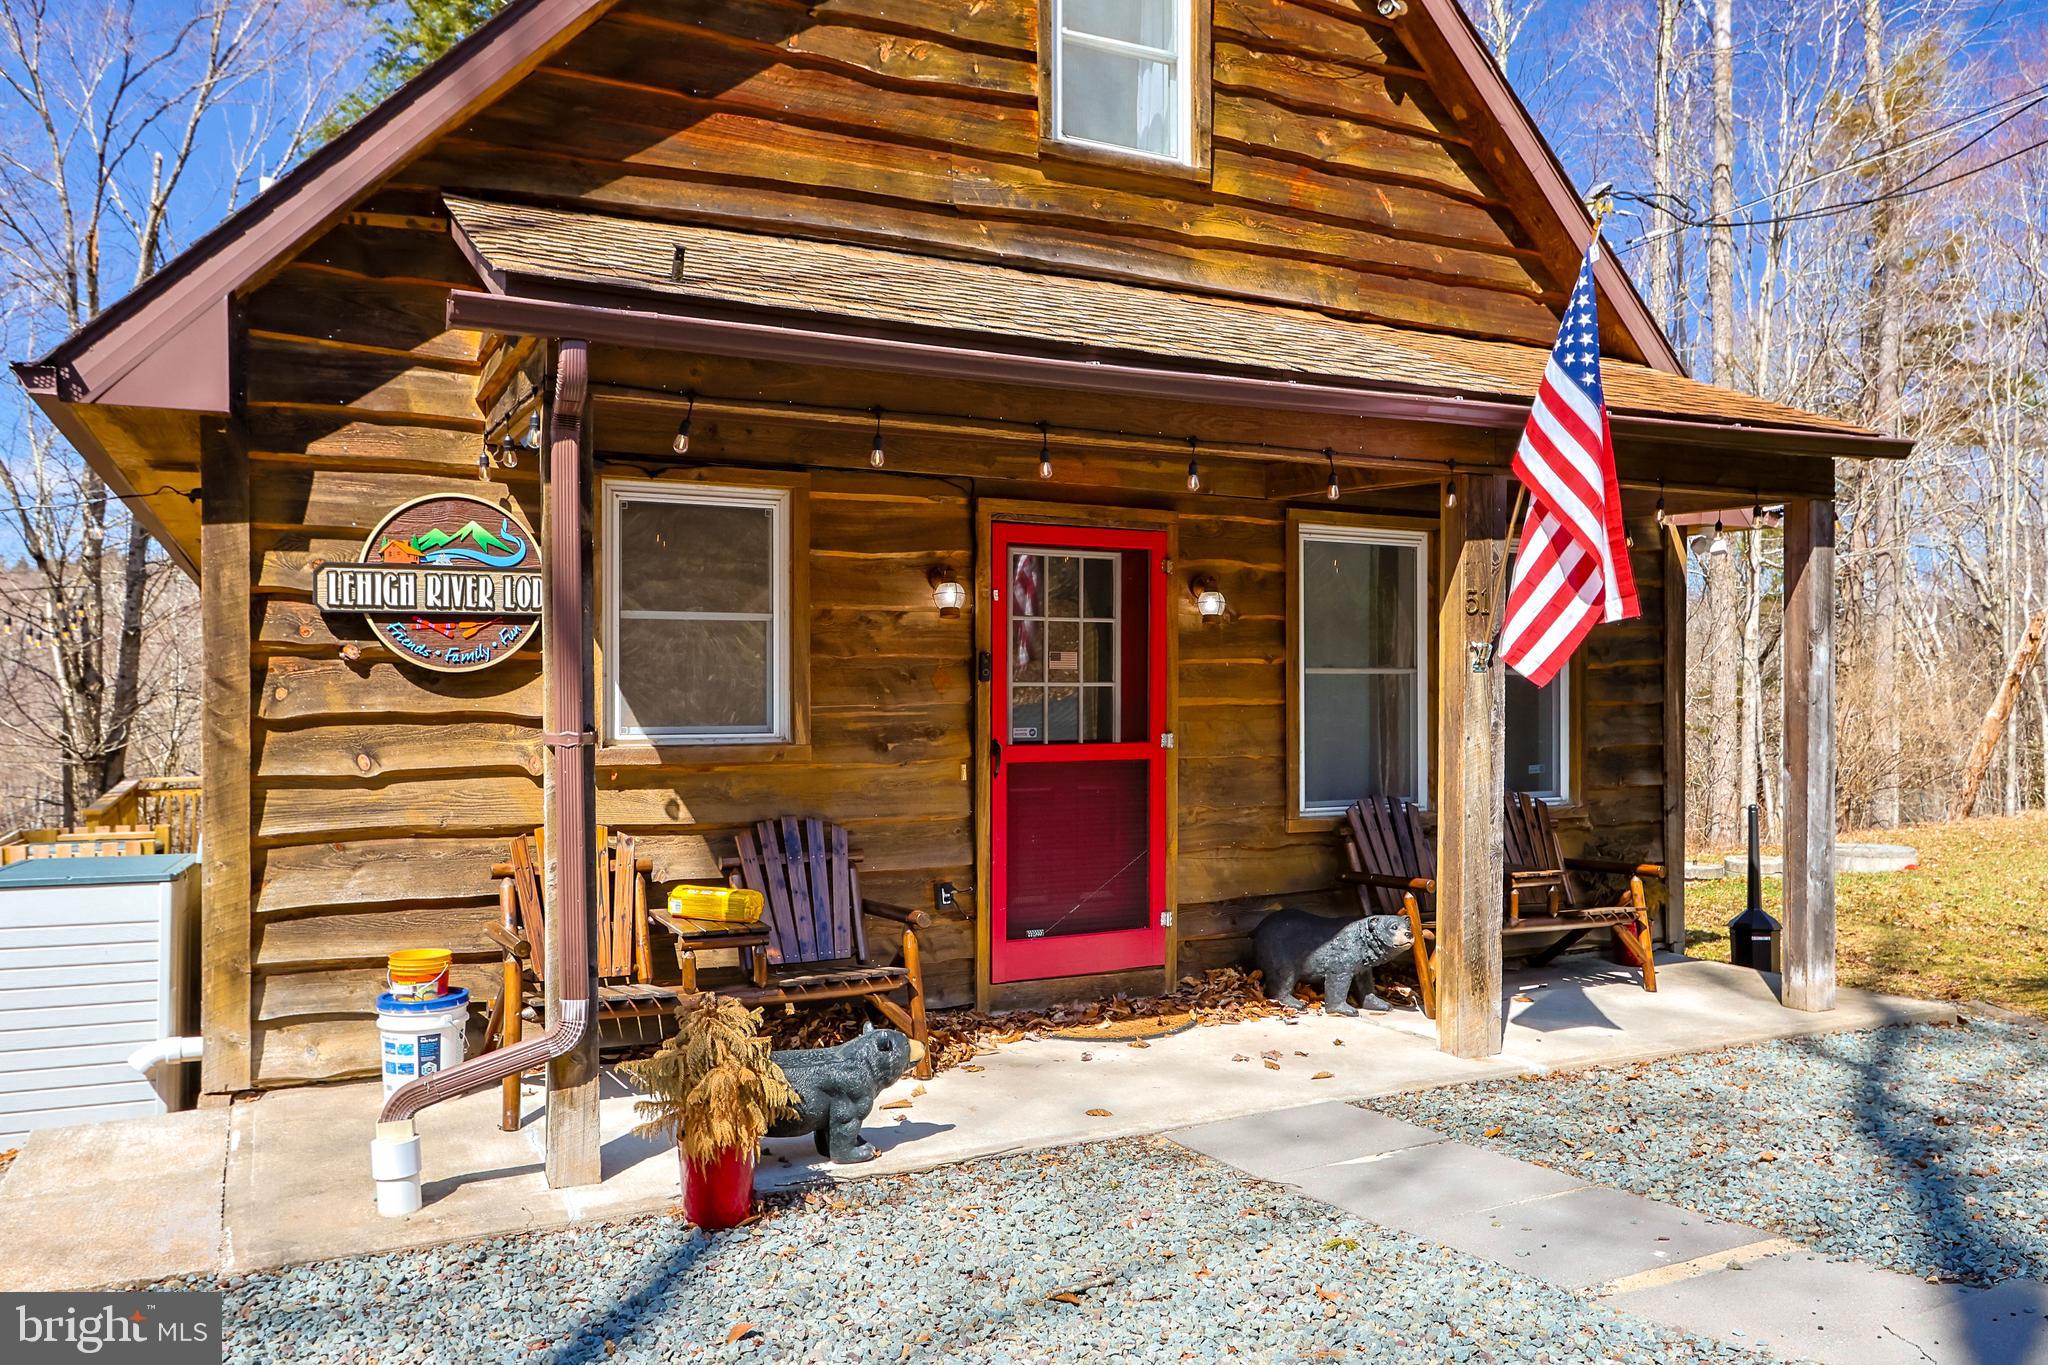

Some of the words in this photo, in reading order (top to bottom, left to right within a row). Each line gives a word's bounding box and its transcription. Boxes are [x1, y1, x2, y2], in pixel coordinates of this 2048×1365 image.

[327, 570, 418, 609] LEHIGH
[425, 572, 495, 611] RIVER
[1465, 587, 1490, 616] 51
[387, 622, 432, 658] Friends
[445, 643, 491, 663] Family
[499, 625, 522, 646] Fun
